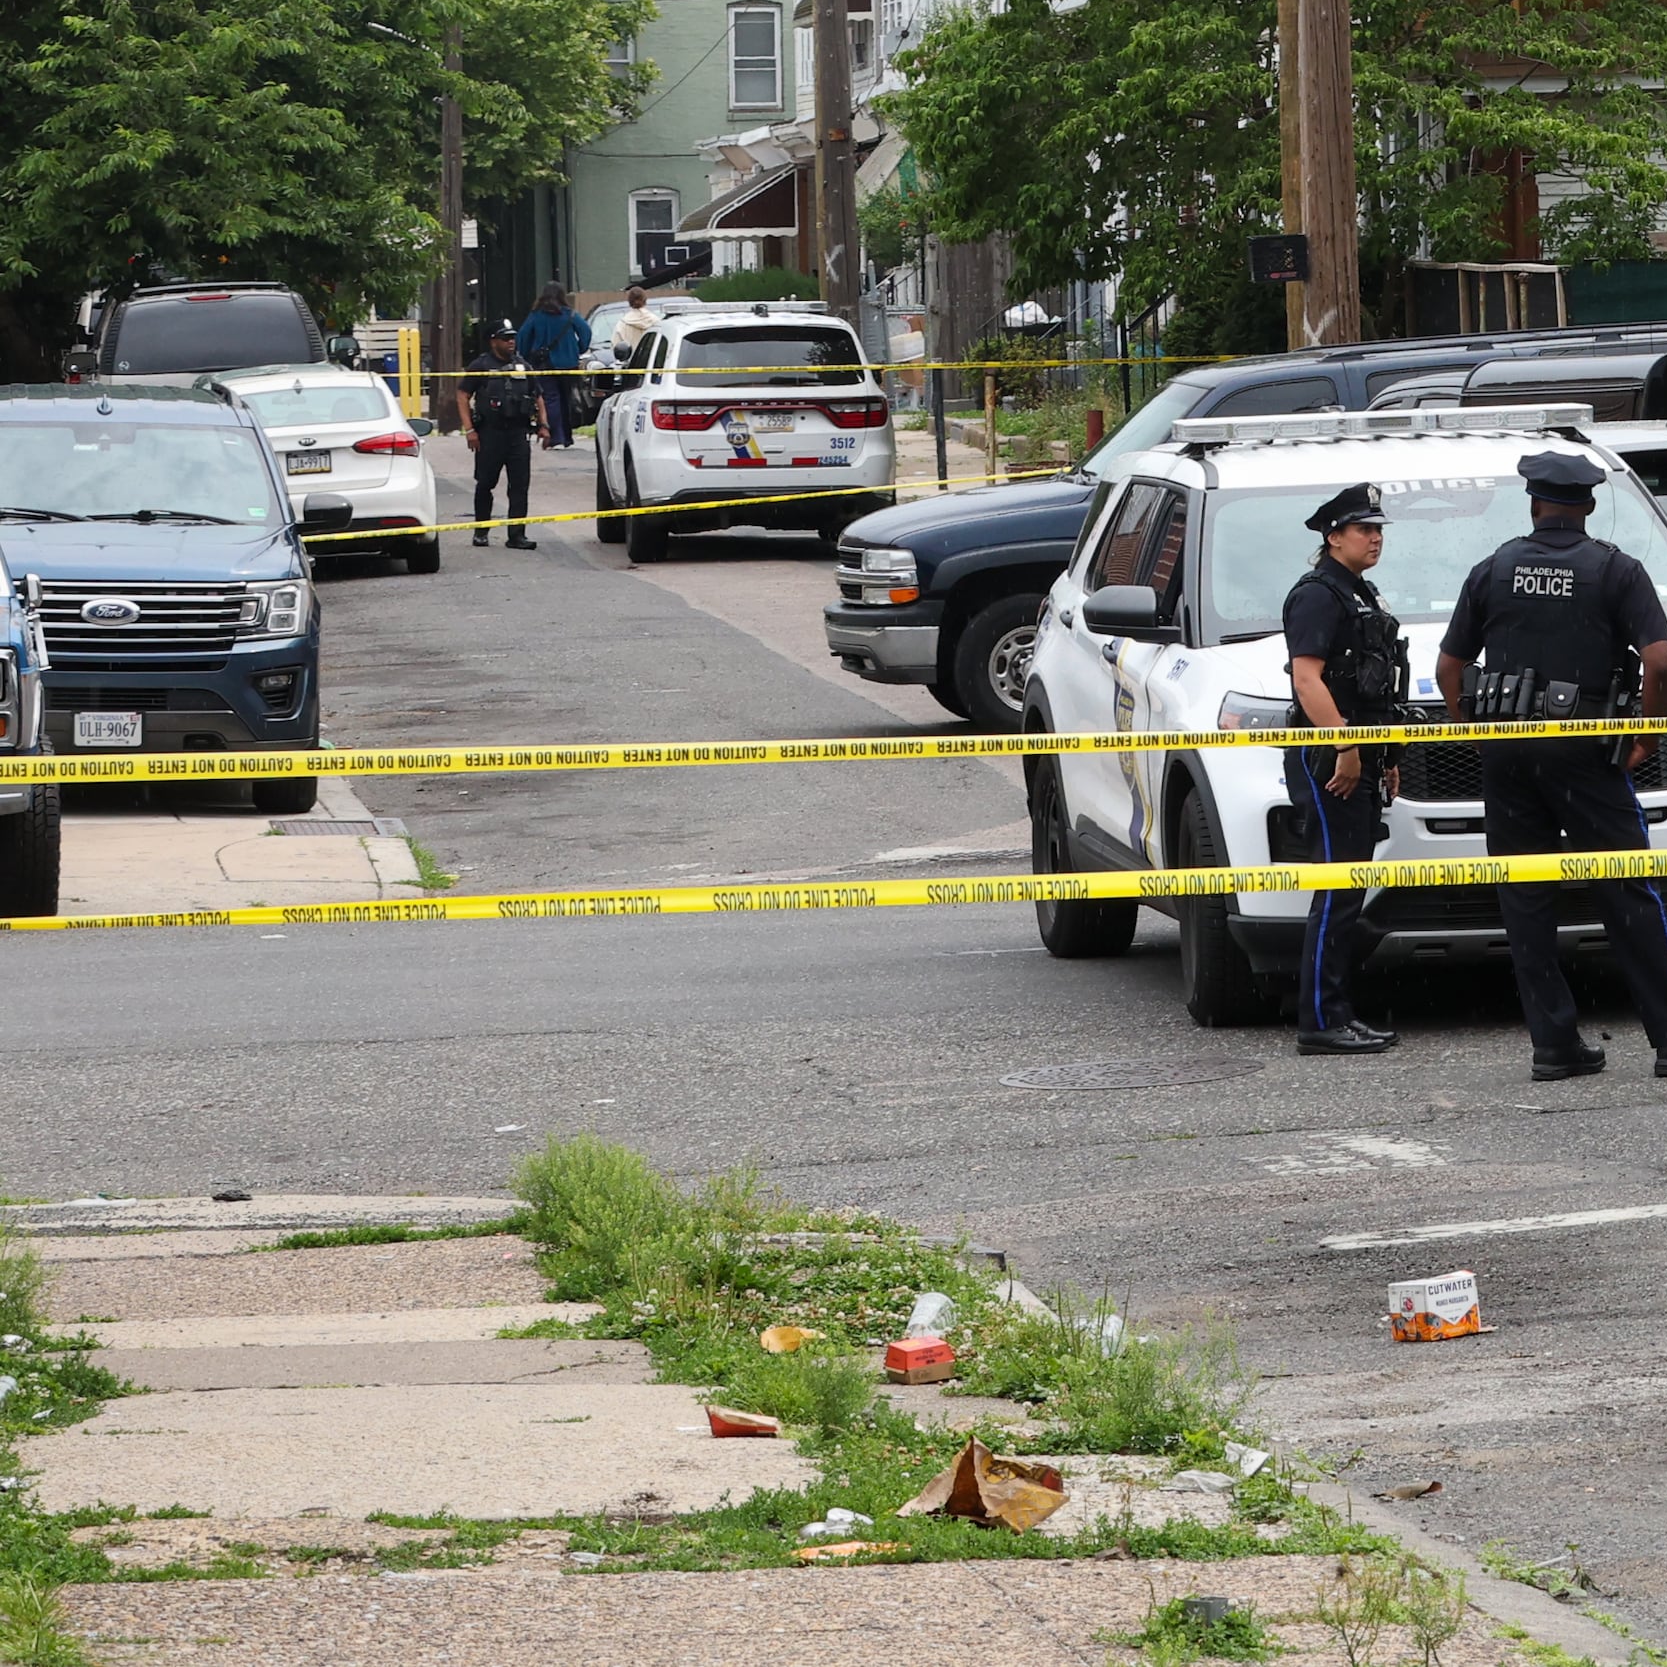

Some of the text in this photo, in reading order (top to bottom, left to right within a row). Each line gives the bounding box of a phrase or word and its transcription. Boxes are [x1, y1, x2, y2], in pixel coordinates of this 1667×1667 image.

[830, 437, 856, 449] 3512
[1374, 477, 1497, 495] OLICE
[1515, 566, 1574, 577] PHILADELPHIA
[1513, 575, 1574, 597] POLICE
[95, 604, 125, 618] Ford
[79, 722, 138, 737] ULH-9067
[1404, 722, 1546, 738] CAUTION DO NOT ENTER
[1559, 721, 1597, 732] ENTER
[1601, 720, 1625, 731] NOT
[1628, 719, 1645, 730] DO
[1093, 732, 1235, 748] CAUTION DO NOT ENTER
[1248, 727, 1391, 743] CAUTION DO NOT ENTER
[780, 741, 923, 758] CAUTION DO NOT ENTER
[936, 737, 1080, 753] CAUTION DO NOT ENTER
[306, 754, 451, 771] CAUTION DO NOT ENTER
[465, 750, 609, 767] CAUTION DO NOT ENTER
[623, 746, 766, 763] CAUTION DO NOT ENTER
[0, 760, 134, 778] CAUTION DO NOT ENTE
[147, 757, 293, 774] CAUTION DO NOT ENTER
[1350, 862, 1509, 887] POLICE LINE DO NOT CROSS
[1560, 857, 1599, 879] CROSS
[1603, 857, 1625, 877] NOT
[1629, 856, 1645, 876] DO
[927, 879, 1088, 903] POLICE LINE DO NOT CROSS
[1139, 871, 1299, 895] POLICE LINE DO NOT CROSS
[713, 888, 875, 910] POLICE LINE DO NOT CROSS
[1428, 1279, 1473, 1295] CUTWATER
